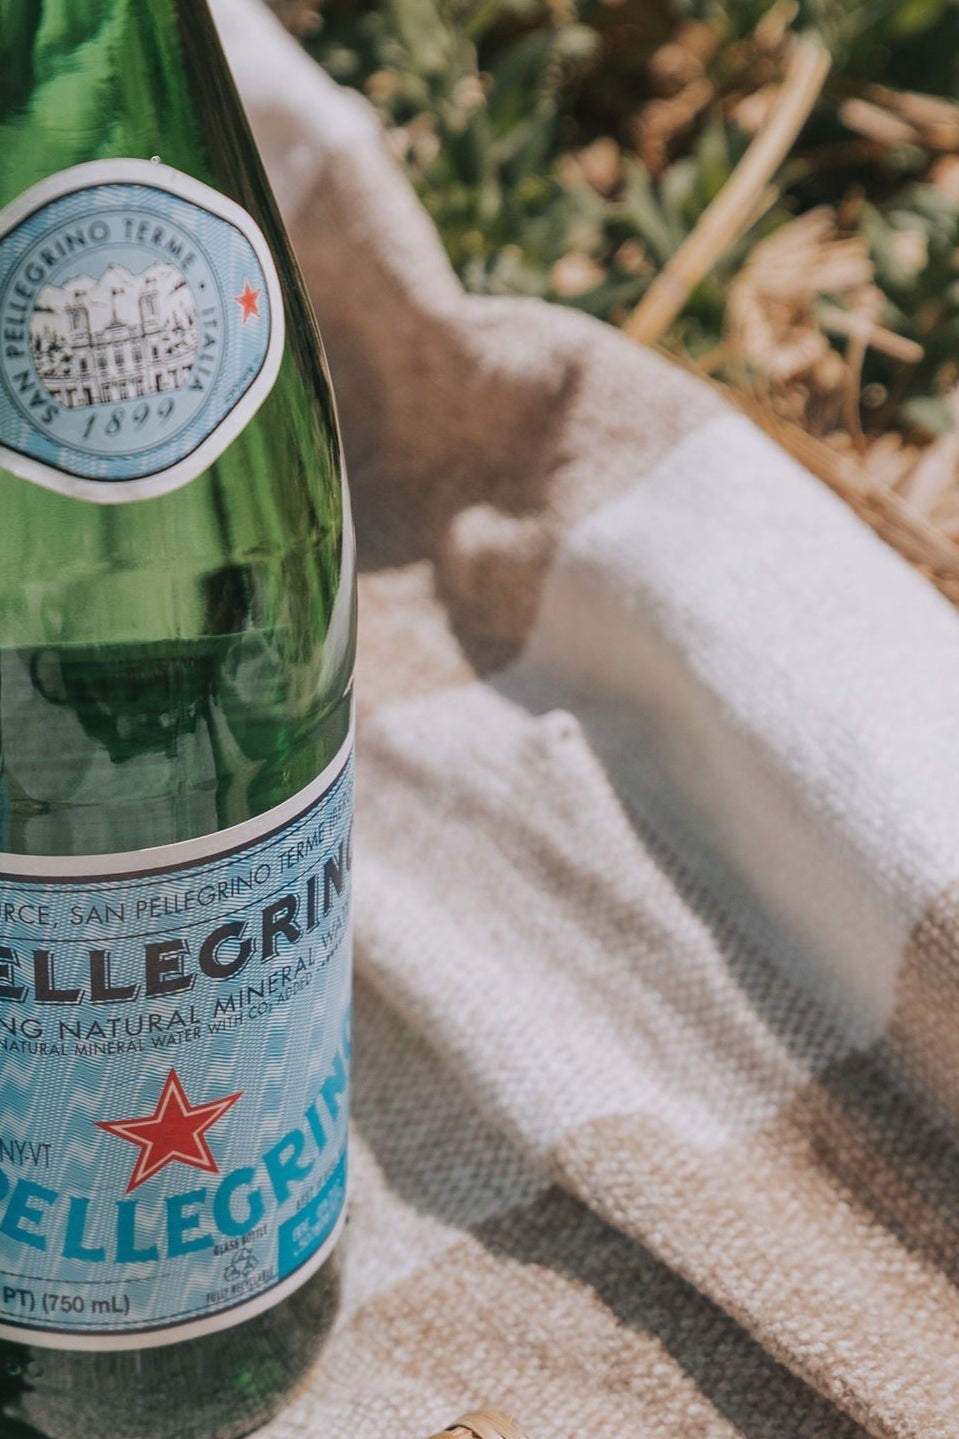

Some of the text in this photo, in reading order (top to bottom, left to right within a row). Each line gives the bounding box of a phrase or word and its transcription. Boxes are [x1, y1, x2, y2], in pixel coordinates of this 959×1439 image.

[122, 217, 198, 271] TERME
[3, 219, 112, 363] PELLEGRINO
[187, 306, 217, 394] ITALIA
[13, 365, 60, 427] SAN
[81, 397, 177, 442] 1899
[70, 902, 126, 927] SAN
[136, 863, 271, 921] PELLEGRINO
[279, 821, 325, 874] TERME
[59, 1005, 200, 1041] NATURAL
[214, 948, 316, 1019] MINERAL
[74, 1039, 145, 1056] MINERAL
[151, 1025, 201, 1049] WATER
[208, 1013, 243, 1035] WITH
[278, 972, 313, 1006] ADDED
[212, 1237, 240, 1257] GLASS
[3, 1286, 37, 1312] PT)
[42, 1292, 86, 1315] (750
[91, 1294, 132, 1317] mL)
